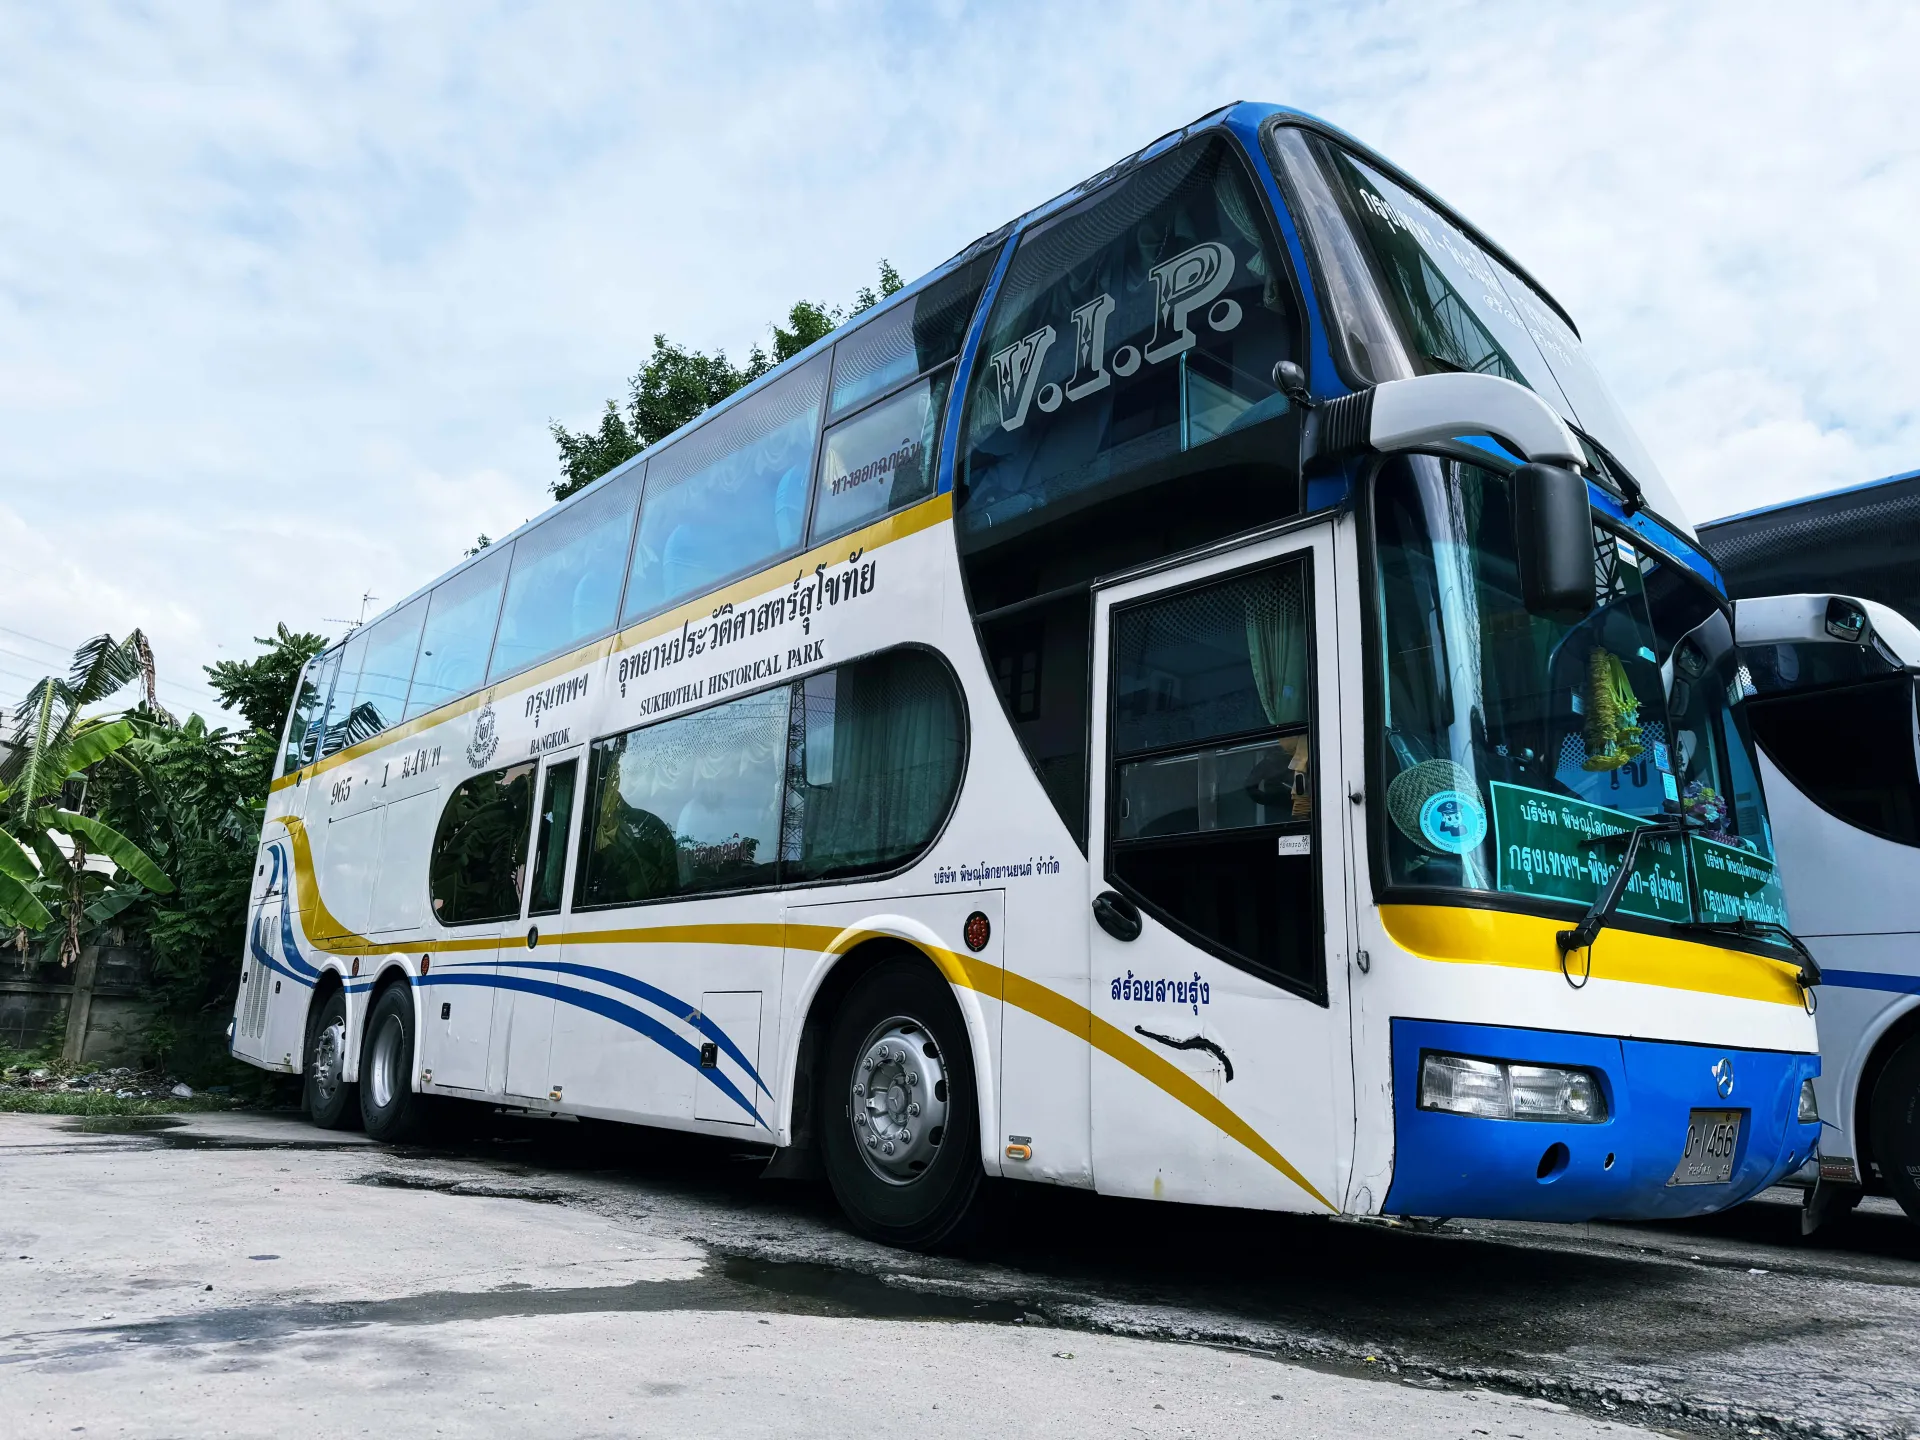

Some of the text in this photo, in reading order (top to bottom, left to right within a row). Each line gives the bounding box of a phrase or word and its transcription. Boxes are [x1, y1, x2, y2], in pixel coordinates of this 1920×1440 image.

[990, 241, 1243, 432] V.I.P.
[832, 437, 921, 487] ทางออกฉุกเฉิน
[524, 672, 589, 729] กรุงเทพฯ
[639, 638, 825, 717] SUKHOTHAI HISTORICAL PARK
[529, 727, 571, 755] BANGKOK
[330, 776, 353, 806] 965
[1520, 799, 1558, 826] บริษัท
[933, 855, 1060, 887] บริษัท พิษณุโลกยานยนต์ จำกัด
[1110, 969, 1210, 1016] สร้อยสายรุ้ง
